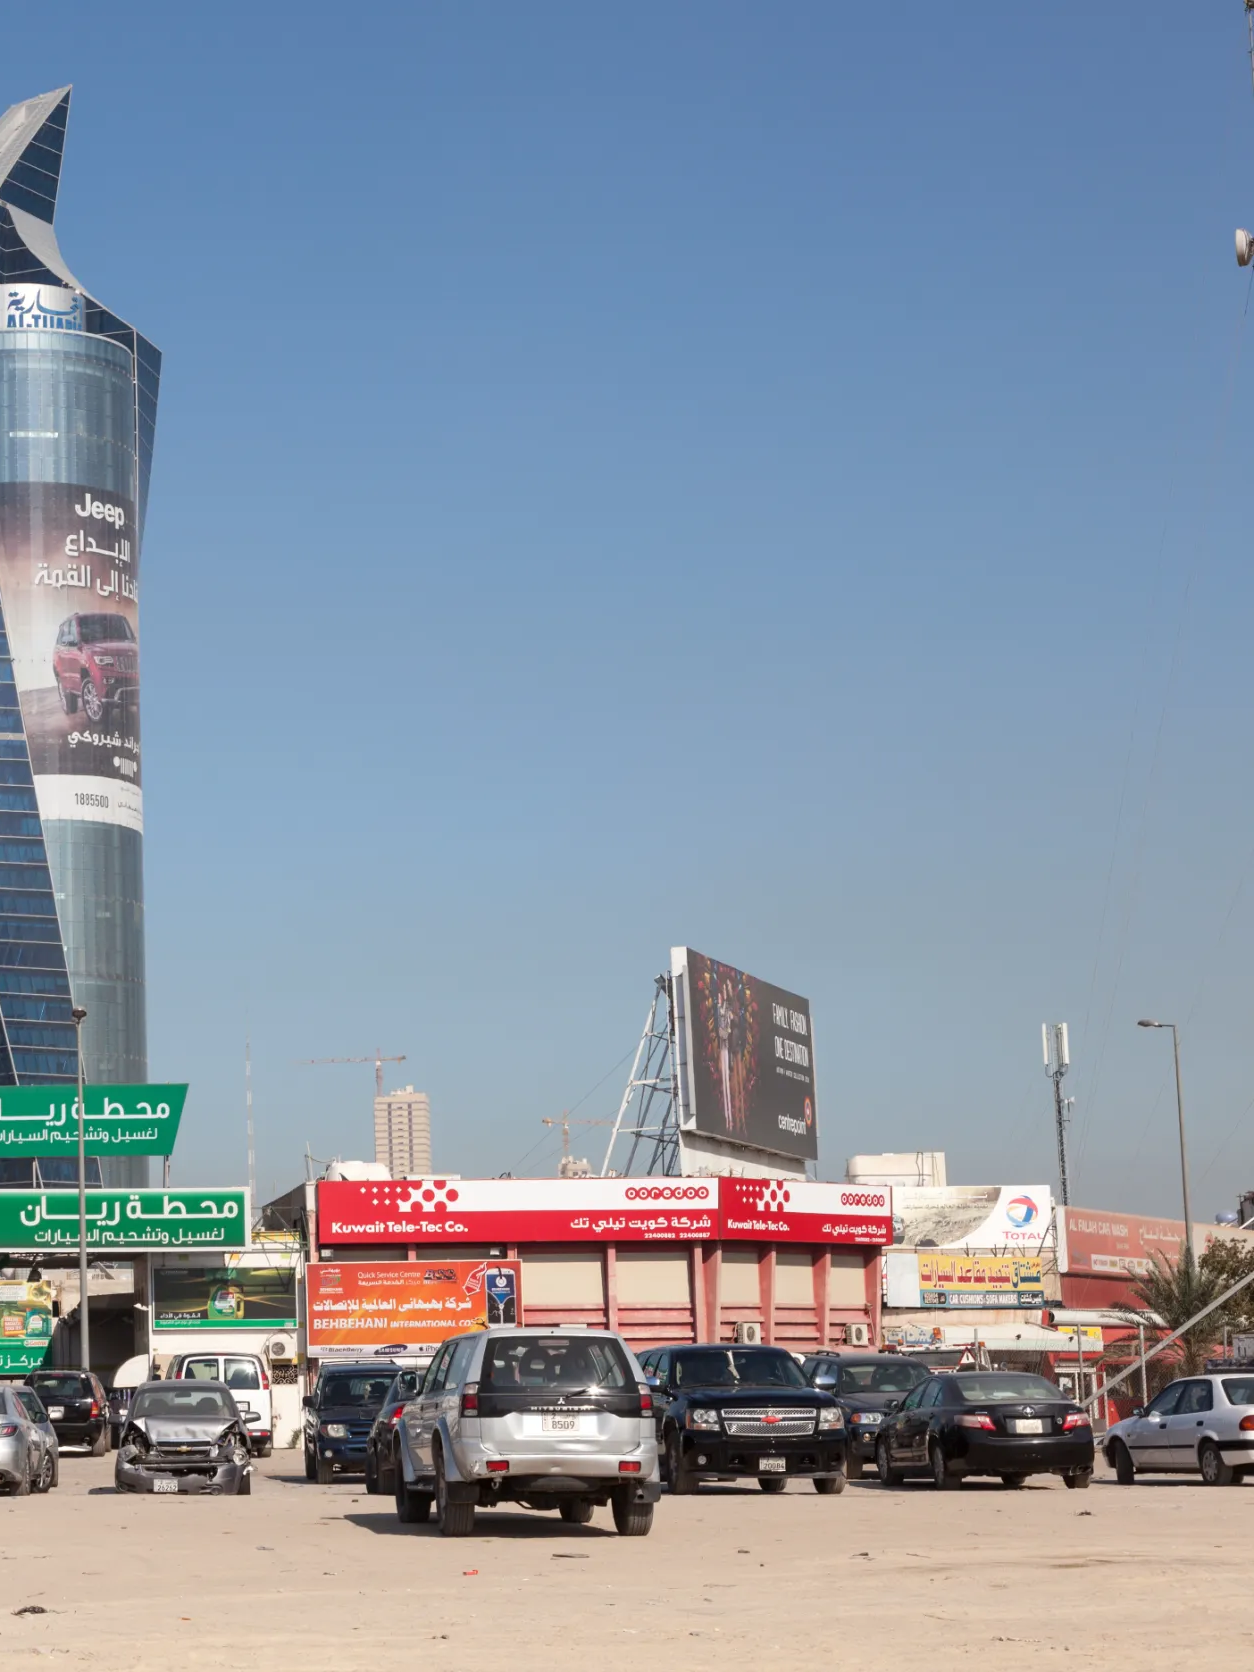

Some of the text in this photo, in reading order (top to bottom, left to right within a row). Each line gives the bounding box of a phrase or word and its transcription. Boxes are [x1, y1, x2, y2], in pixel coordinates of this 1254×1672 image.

[75, 493, 124, 529] Jeep
[35, 563, 91, 588] القمة
[774, 1035, 784, 1059] ONE
[71, 1097, 170, 1119] محطة
[778, 1113, 807, 1136] centrepoint
[111, 1127, 158, 1143] لغسيل
[625, 1186, 709, 1200] ooredoo
[841, 1193, 885, 1207] ooredoo
[20, 1194, 238, 1226] محطة ريان
[331, 1220, 469, 1234] Kuwait Tele-Tec Co.
[570, 1215, 711, 1233] شركة كويت تيلي تك
[727, 1218, 790, 1231] Kuwait Tele-Tec Co.
[849, 1225, 867, 1235] كويت
[868, 1224, 887, 1235] شركة
[1069, 1218, 1077, 1231] AL
[1112, 1223, 1128, 1237] WASH
[101, 1227, 168, 1244] وتشحيم
[171, 1227, 225, 1244] لغسيل
[1002, 1231, 1045, 1240] TOTAL
[362, 1298, 396, 1313] العالمية
[445, 1297, 472, 1312] شركة
[949, 1294, 958, 1304] CAR
[959, 1294, 983, 1304] CUSHIONS
[986, 1294, 999, 1304] SOFA
[999, 1294, 1018, 1304] MAKERS
[313, 1317, 388, 1330] BEHBEHANI
[390, 1320, 457, 1328] INTERNATIONAL
[4, 1355, 43, 1369] مركز
[552, 1421, 575, 1429] 8509
